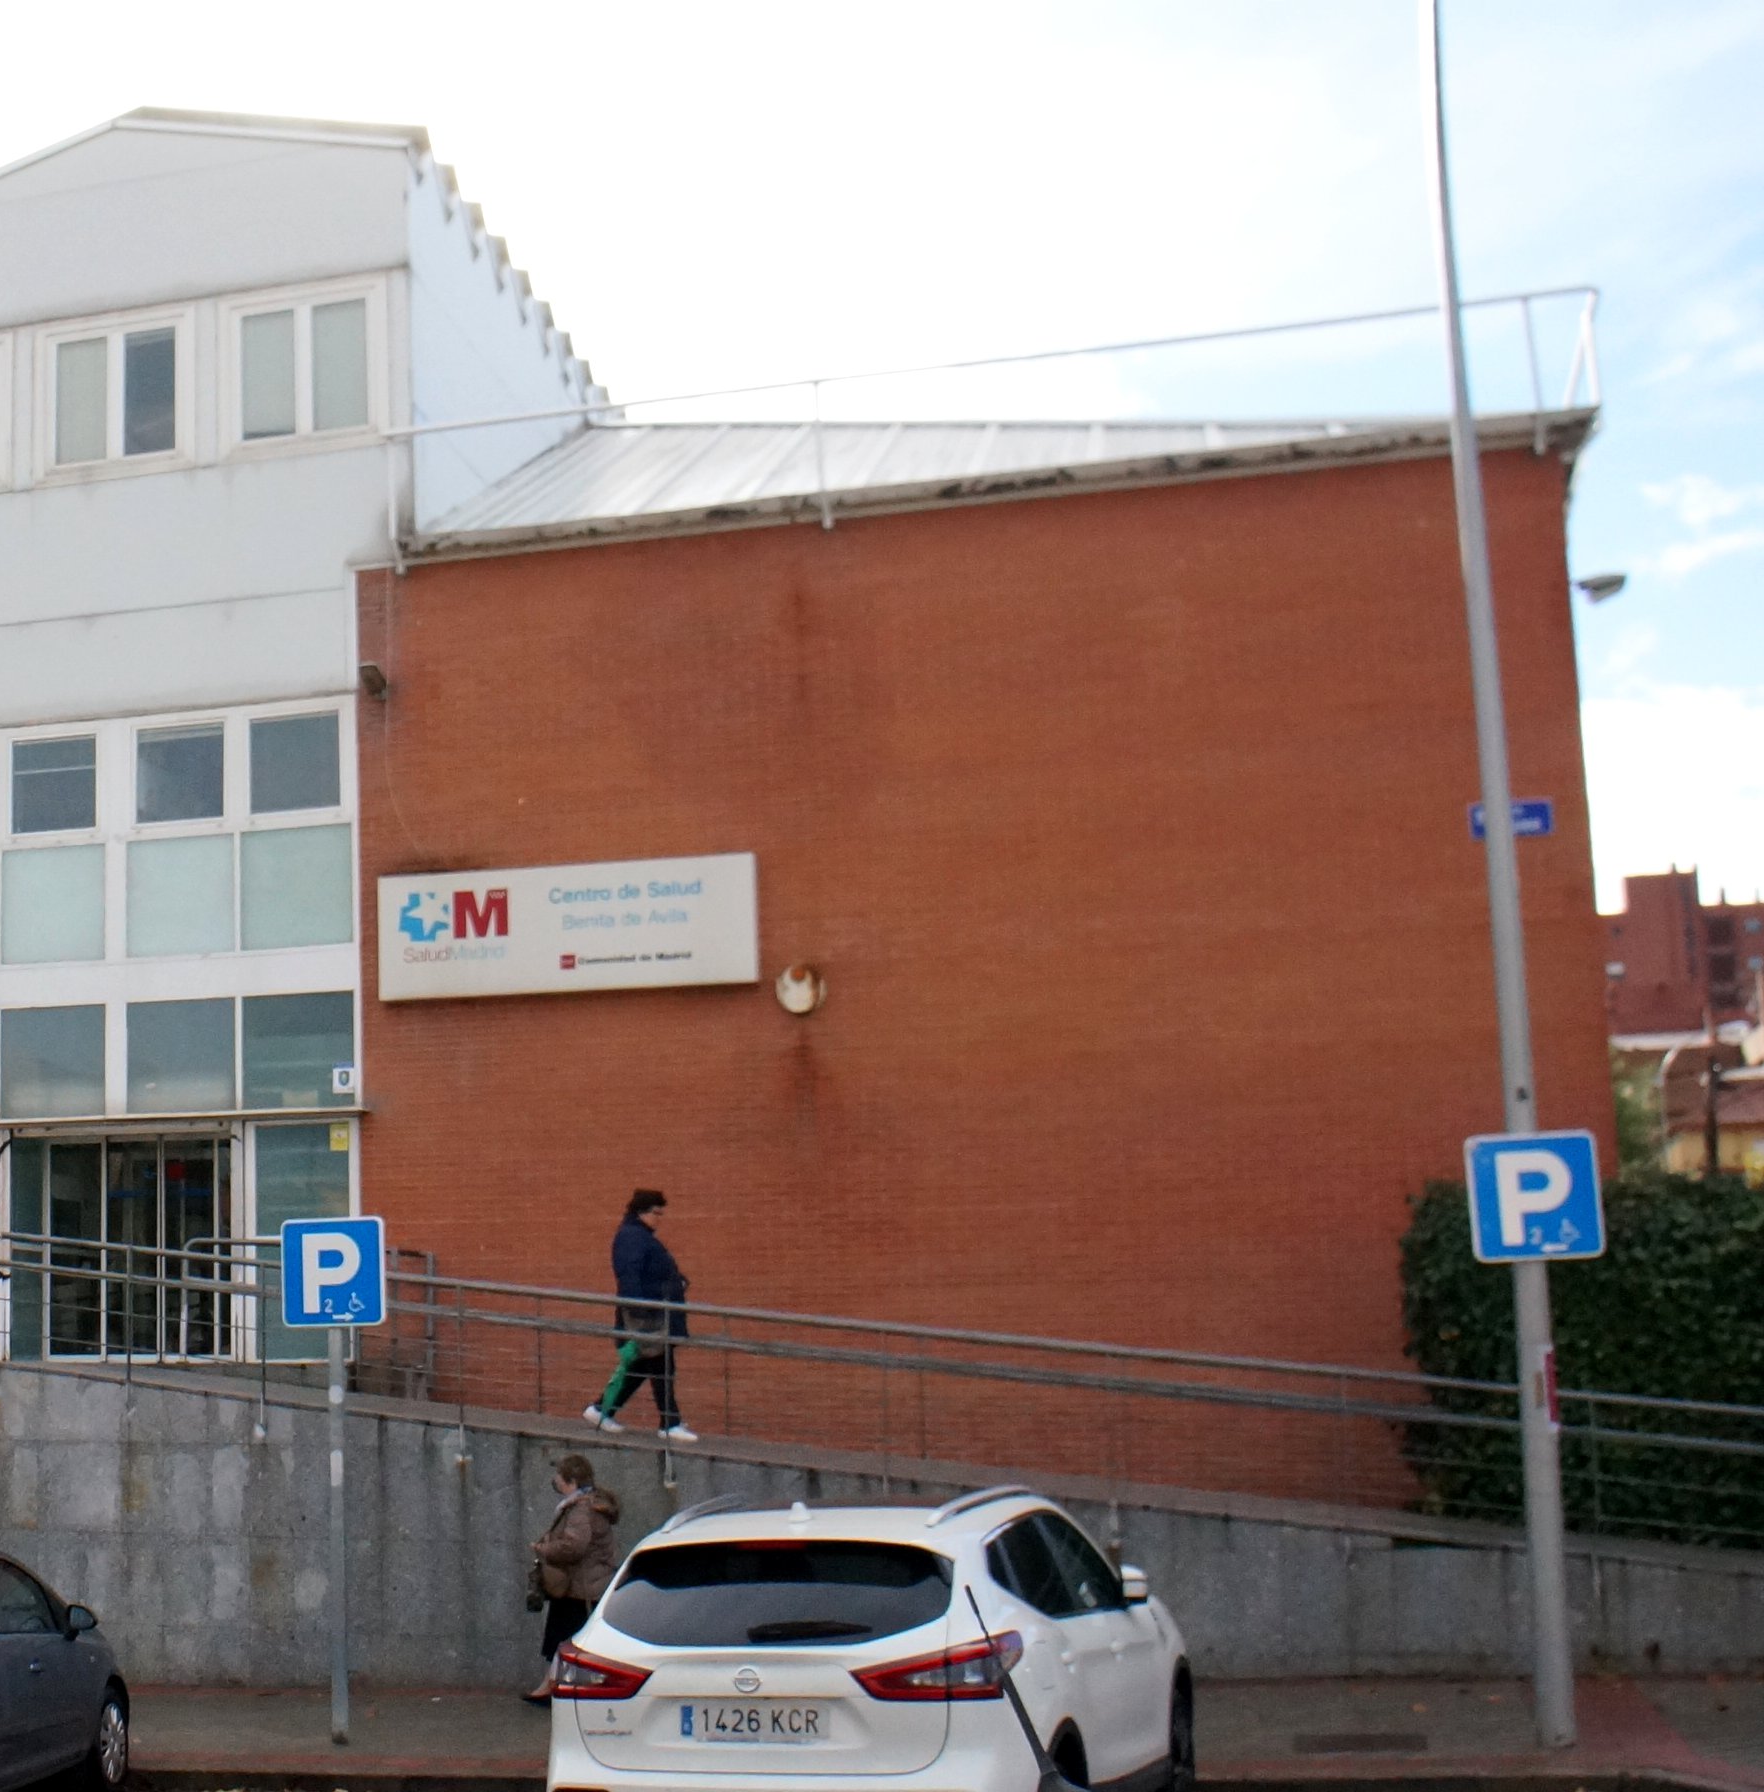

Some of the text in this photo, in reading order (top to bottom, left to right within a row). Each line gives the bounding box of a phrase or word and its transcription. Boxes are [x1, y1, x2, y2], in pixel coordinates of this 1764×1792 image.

[549, 880, 701, 904] Centro de Salud
[562, 913, 615, 930] Benita
[622, 911, 641, 926] de
[655, 950, 691, 961] Madrid
[1494, 1149, 1572, 1247] P
[302, 1232, 361, 1314] P
[323, 1298, 334, 1314] 2
[702, 1708, 820, 1734] 1426 KCR
